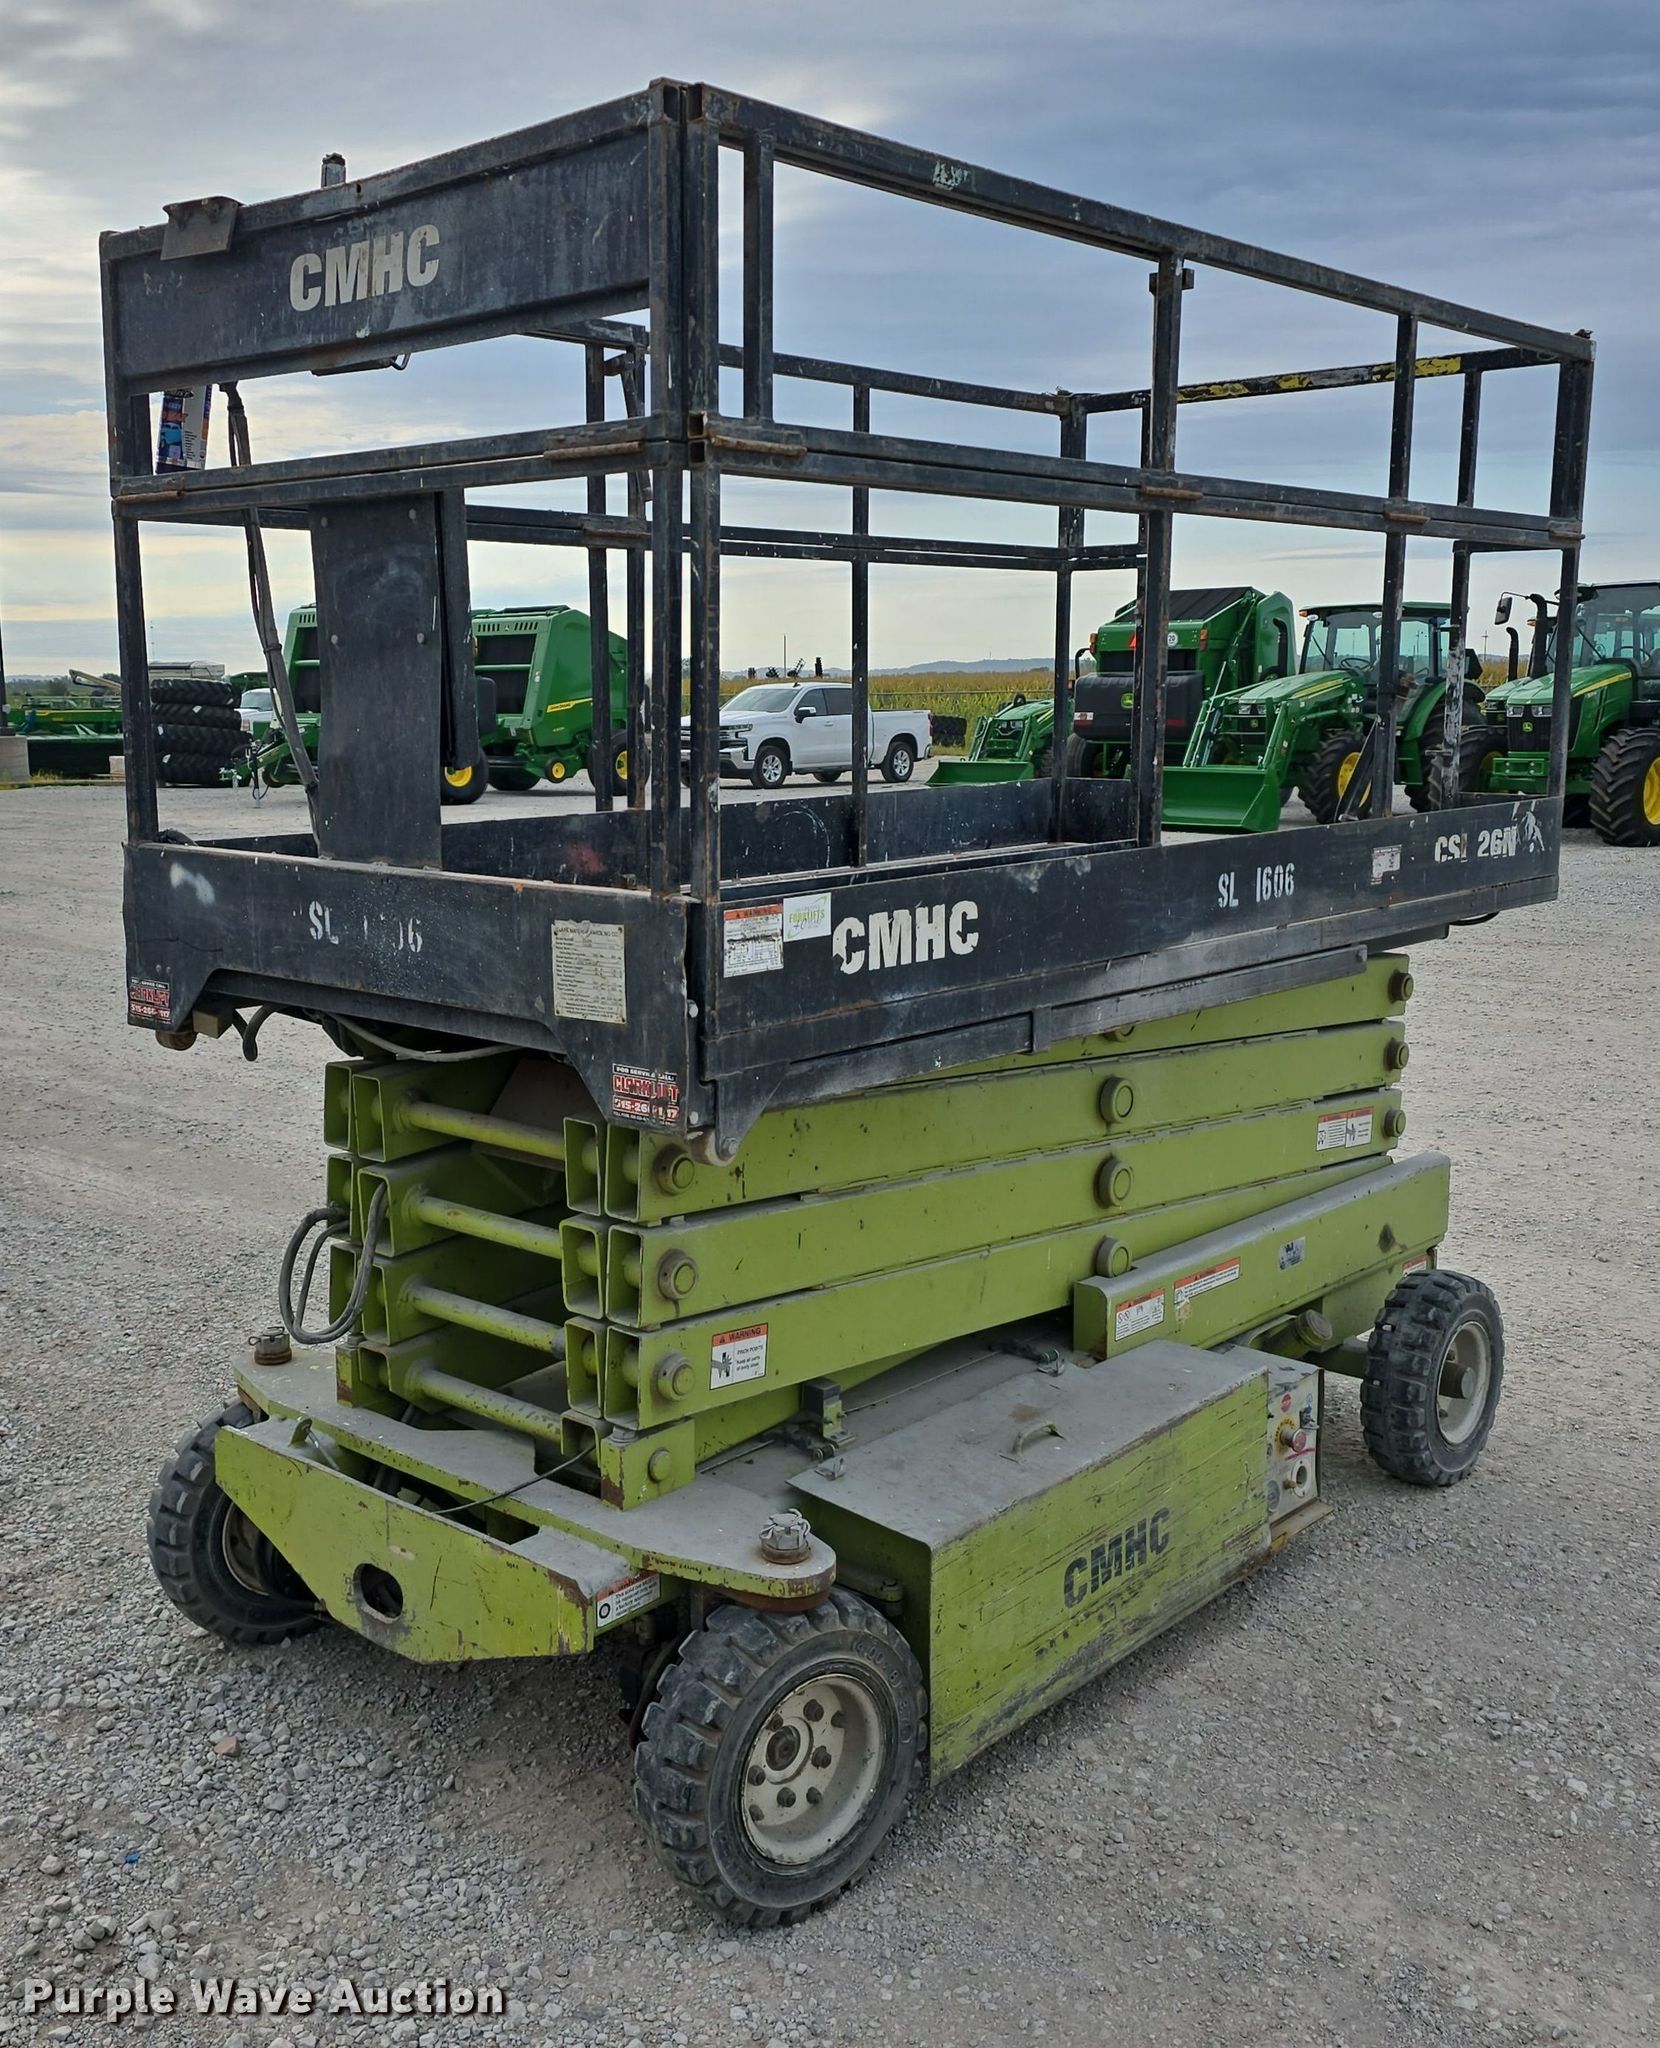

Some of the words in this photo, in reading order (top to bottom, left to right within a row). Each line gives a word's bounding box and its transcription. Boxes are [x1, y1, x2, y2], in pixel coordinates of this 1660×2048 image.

[289, 224, 440, 312] CMHC
[1218, 872, 1239, 908] SL
[1256, 862, 1295, 902] 1606
[309, 901, 338, 944] SL
[833, 900, 979, 974] CMHC
[729, 1328, 761, 1341] WARNING
[1064, 1507, 1170, 1609] CMHC
